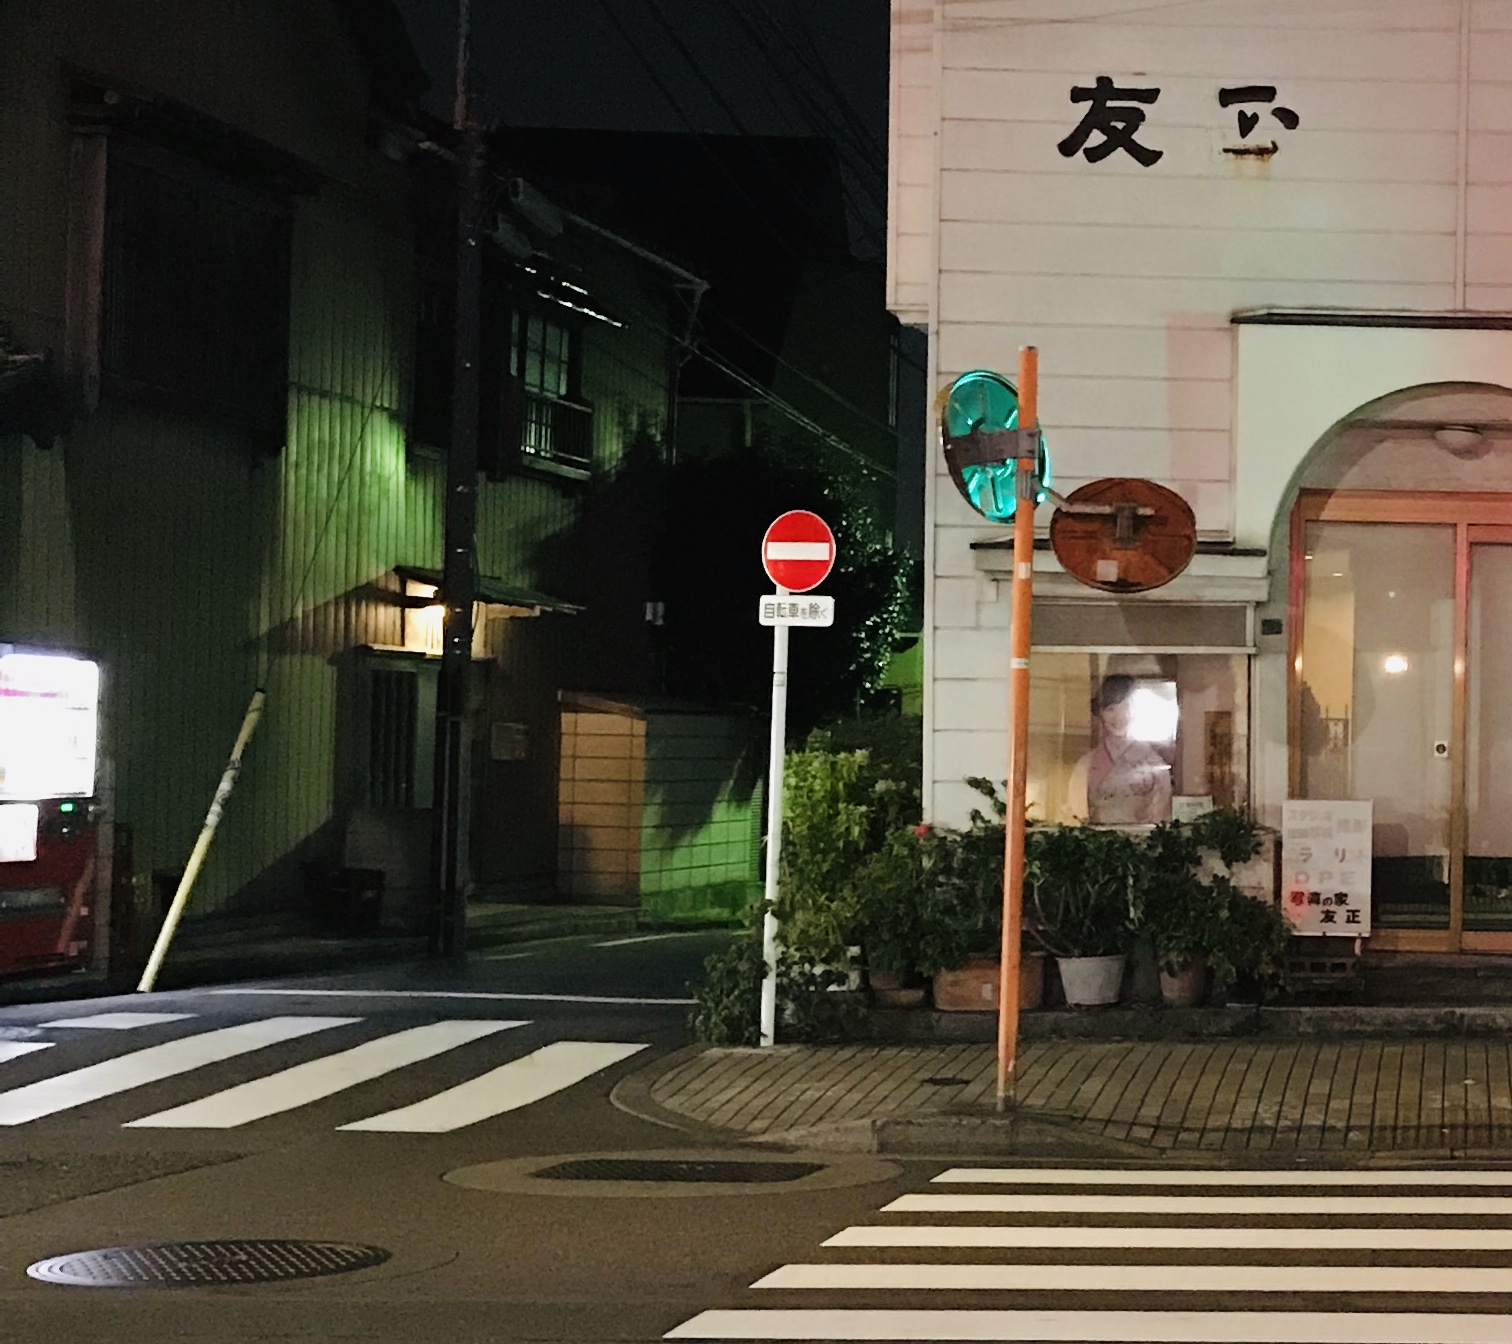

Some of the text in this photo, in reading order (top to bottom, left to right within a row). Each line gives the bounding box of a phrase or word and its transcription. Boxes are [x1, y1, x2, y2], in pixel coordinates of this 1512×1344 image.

[764, 602, 828, 620] 自転車を除く
[1320, 909, 1362, 924] 友正
